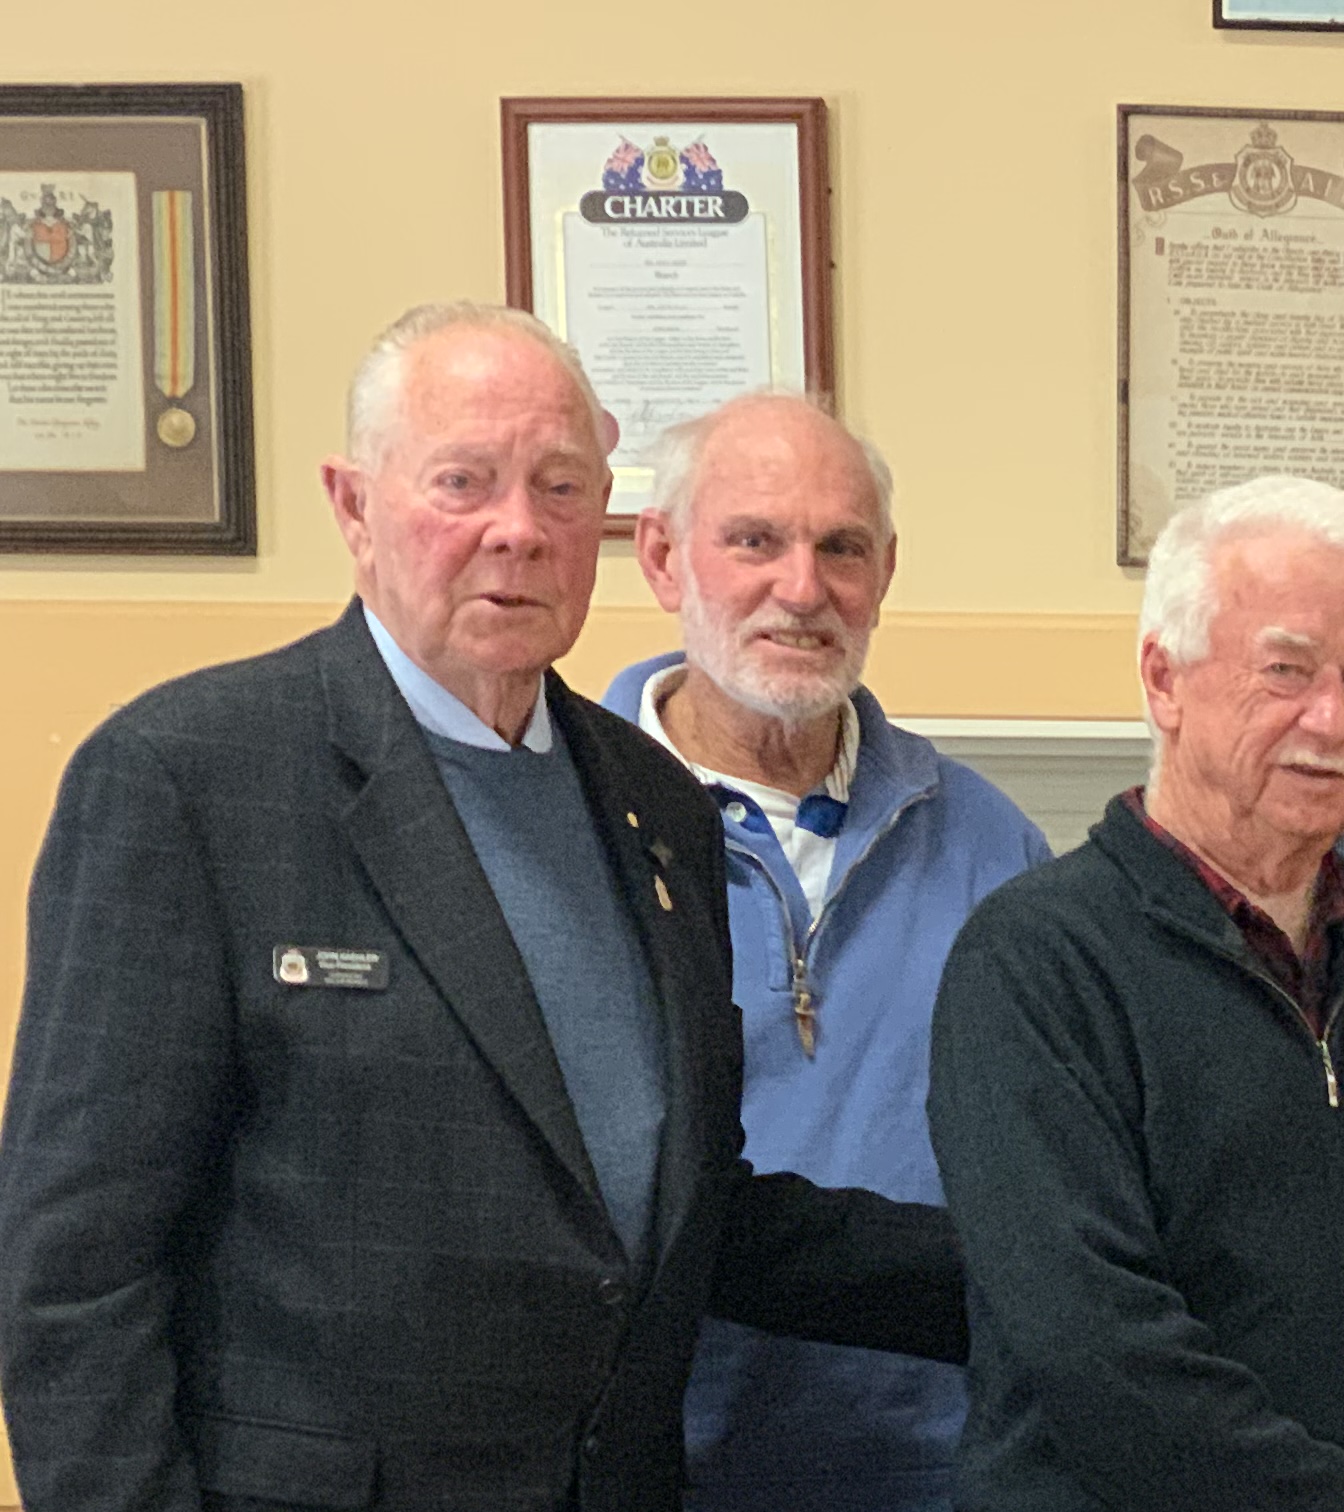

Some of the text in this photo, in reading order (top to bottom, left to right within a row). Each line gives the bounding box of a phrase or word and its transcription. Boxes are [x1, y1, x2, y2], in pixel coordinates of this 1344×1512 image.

[604, 195, 725, 218] CHARTER
[1211, 226, 1239, 240] Oath
[1244, 228, 1254, 241] of
